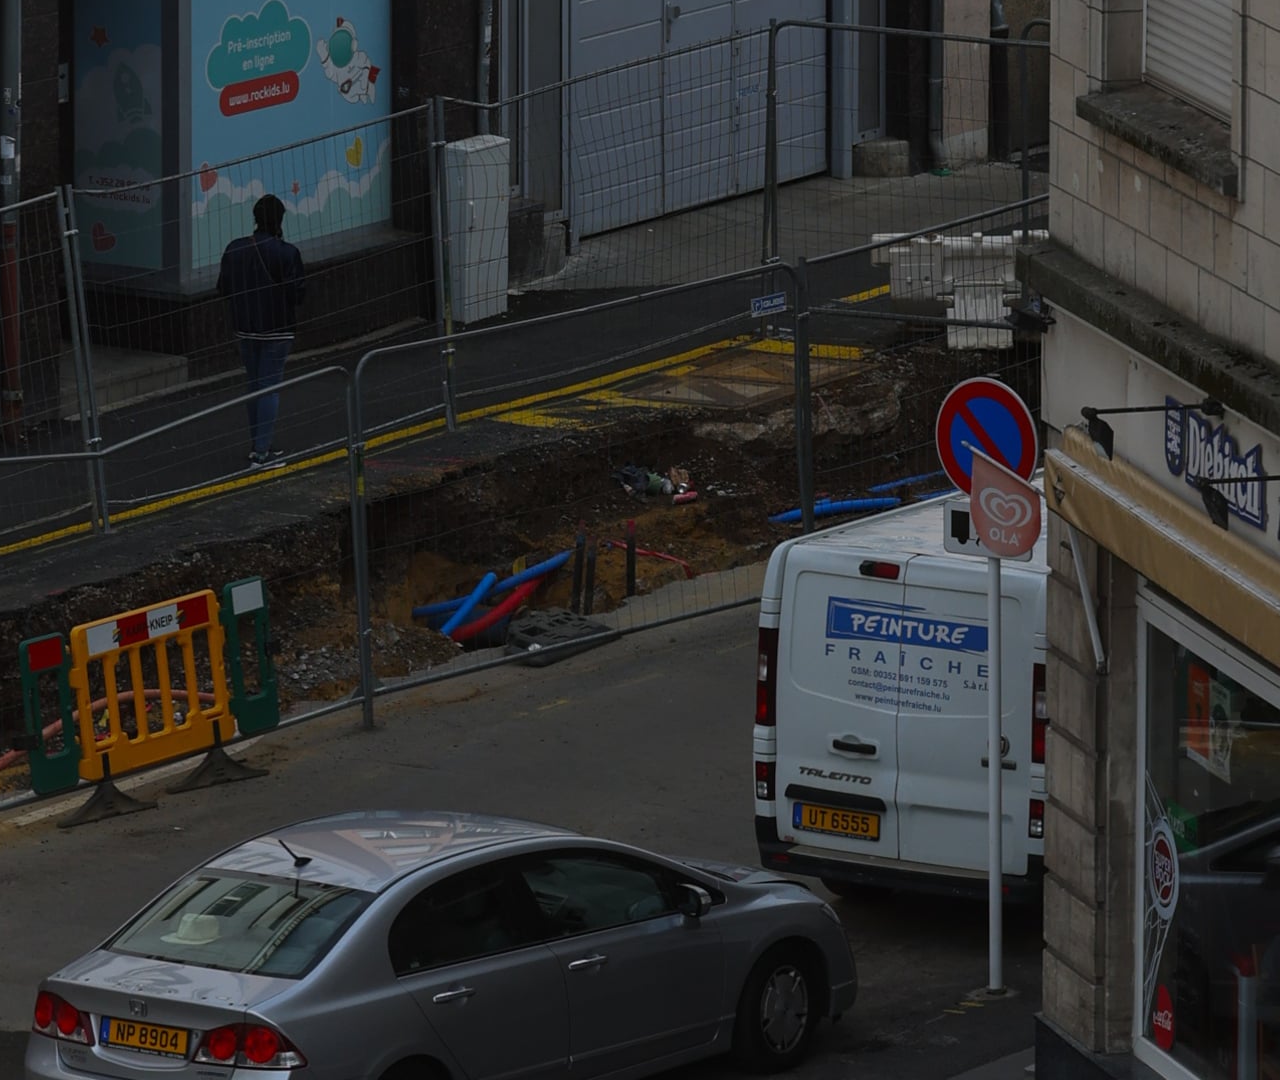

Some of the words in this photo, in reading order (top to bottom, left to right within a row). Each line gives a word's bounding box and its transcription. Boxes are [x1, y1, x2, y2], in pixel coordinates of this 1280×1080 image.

[242, 60, 253, 71] en
[254, 54, 275, 71] ligne
[229, 81, 290, 107] www.rockids.lu
[989, 527, 1019, 547] OLA
[850, 613, 969, 645] PEINTURE
[851, 666, 872, 678] GSM:
[873, 670, 897, 682] 00352
[917, 676, 930, 687] 159
[933, 679, 948, 689] 575
[799, 766, 872, 785] TALENTO
[809, 808, 827, 827] UT
[831, 813, 870, 833] 6555
[115, 1022, 136, 1043] NP
[139, 1026, 179, 1050] 8904
